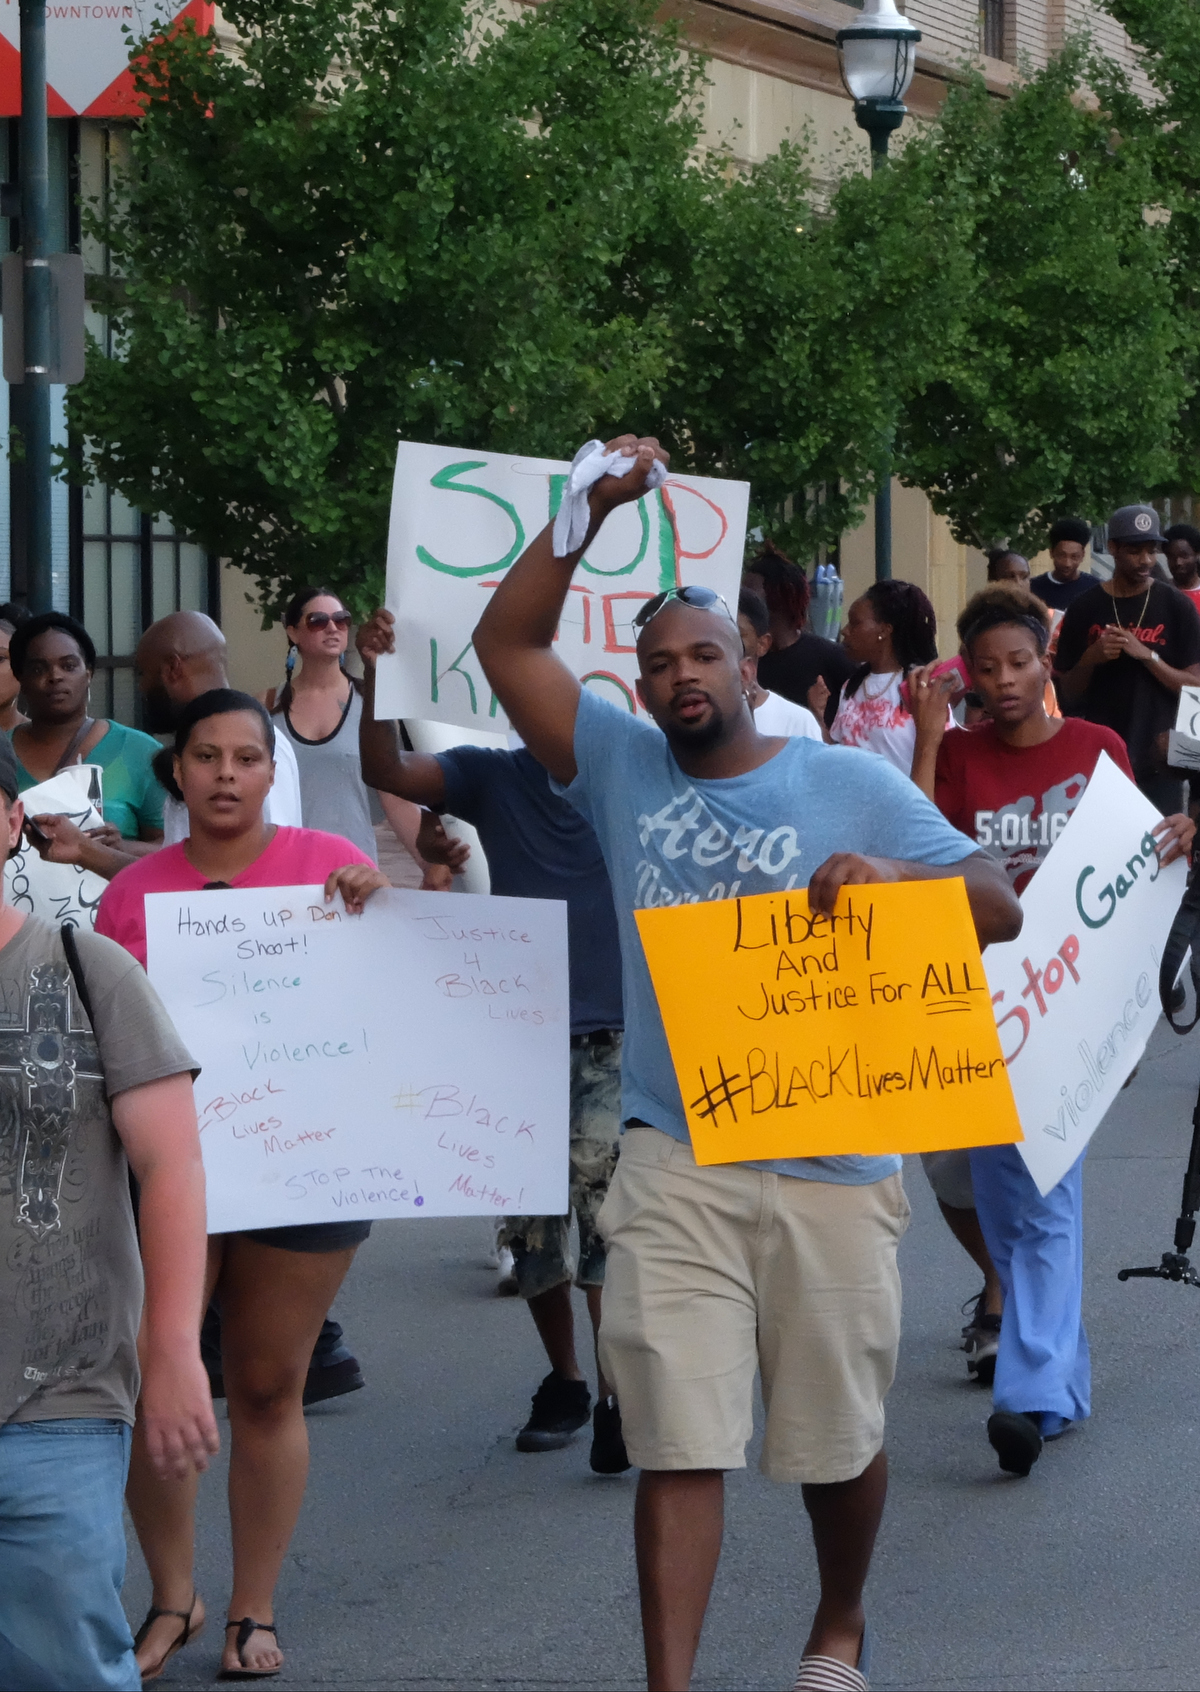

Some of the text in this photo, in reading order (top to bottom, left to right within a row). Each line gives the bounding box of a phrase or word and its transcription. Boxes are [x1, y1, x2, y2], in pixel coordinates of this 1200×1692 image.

[45, 5, 133, 18] OWNTOWN
[416, 461, 728, 593] SOP
[637, 785, 802, 875] Hero
[177, 907, 246, 937] Hands
[307, 905, 364, 922] Don
[412, 915, 532, 944] Justice
[733, 898, 874, 961] Liberty
[237, 934, 310, 960] Shoot!
[463, 952, 482, 972] 4
[776, 938, 839, 981] And
[991, 934, 1081, 1066] Stop
[1075, 831, 1162, 930] Gang
[193, 971, 302, 1007] Silence
[737, 962, 986, 1021] Justice For ALL
[253, 1010, 272, 1025] is
[488, 1004, 546, 1025] Lives
[242, 1028, 370, 1071] Violence!
[232, 1116, 283, 1140] Lives
[264, 1128, 337, 1156] Matter
[437, 1131, 497, 1169] Lives
